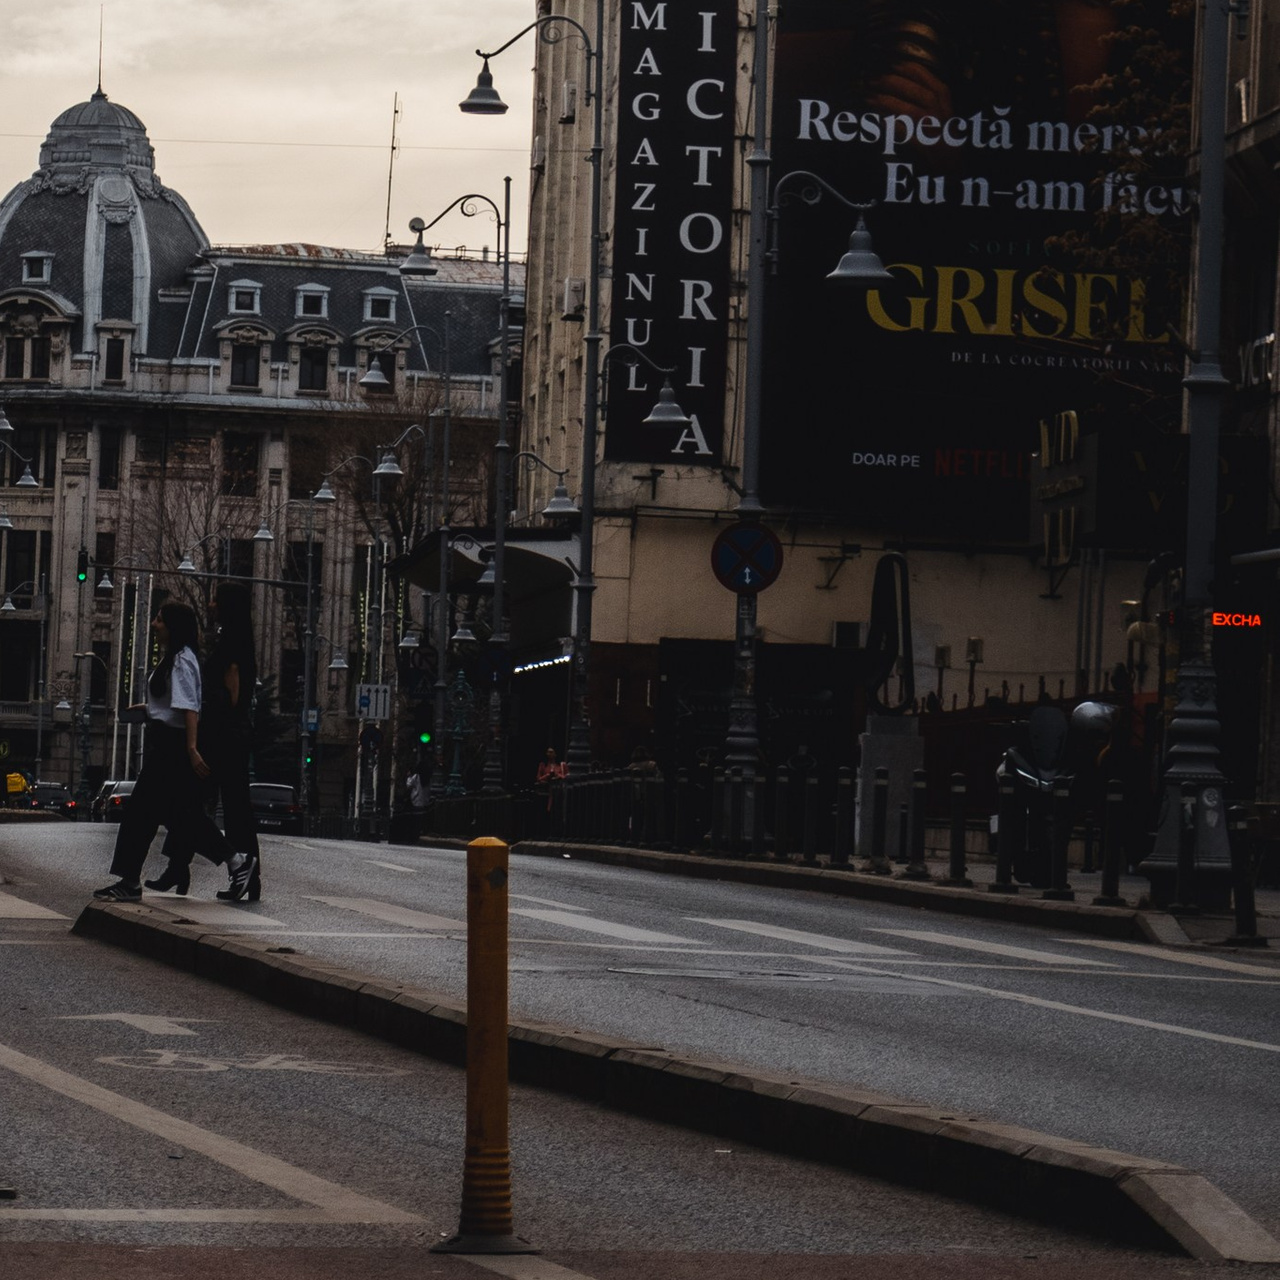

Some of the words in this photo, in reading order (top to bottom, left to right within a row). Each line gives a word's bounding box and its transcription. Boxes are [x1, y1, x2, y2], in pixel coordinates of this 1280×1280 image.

[797, 98, 1014, 156] Respectă
[1026, 120, 1174, 157] mere
[625, 1, 668, 392] MAGAZINUL
[883, 162, 946, 205] Eu
[865, 263, 1188, 346] GRISEL
[951, 351, 973, 363] DE
[981, 352, 1001, 365] LA
[852, 452, 897, 467] DOAR
[900, 454, 921, 468] PE
[934, 447, 1031, 482] NETFLI
[1212, 612, 1262, 627] EXCHA
